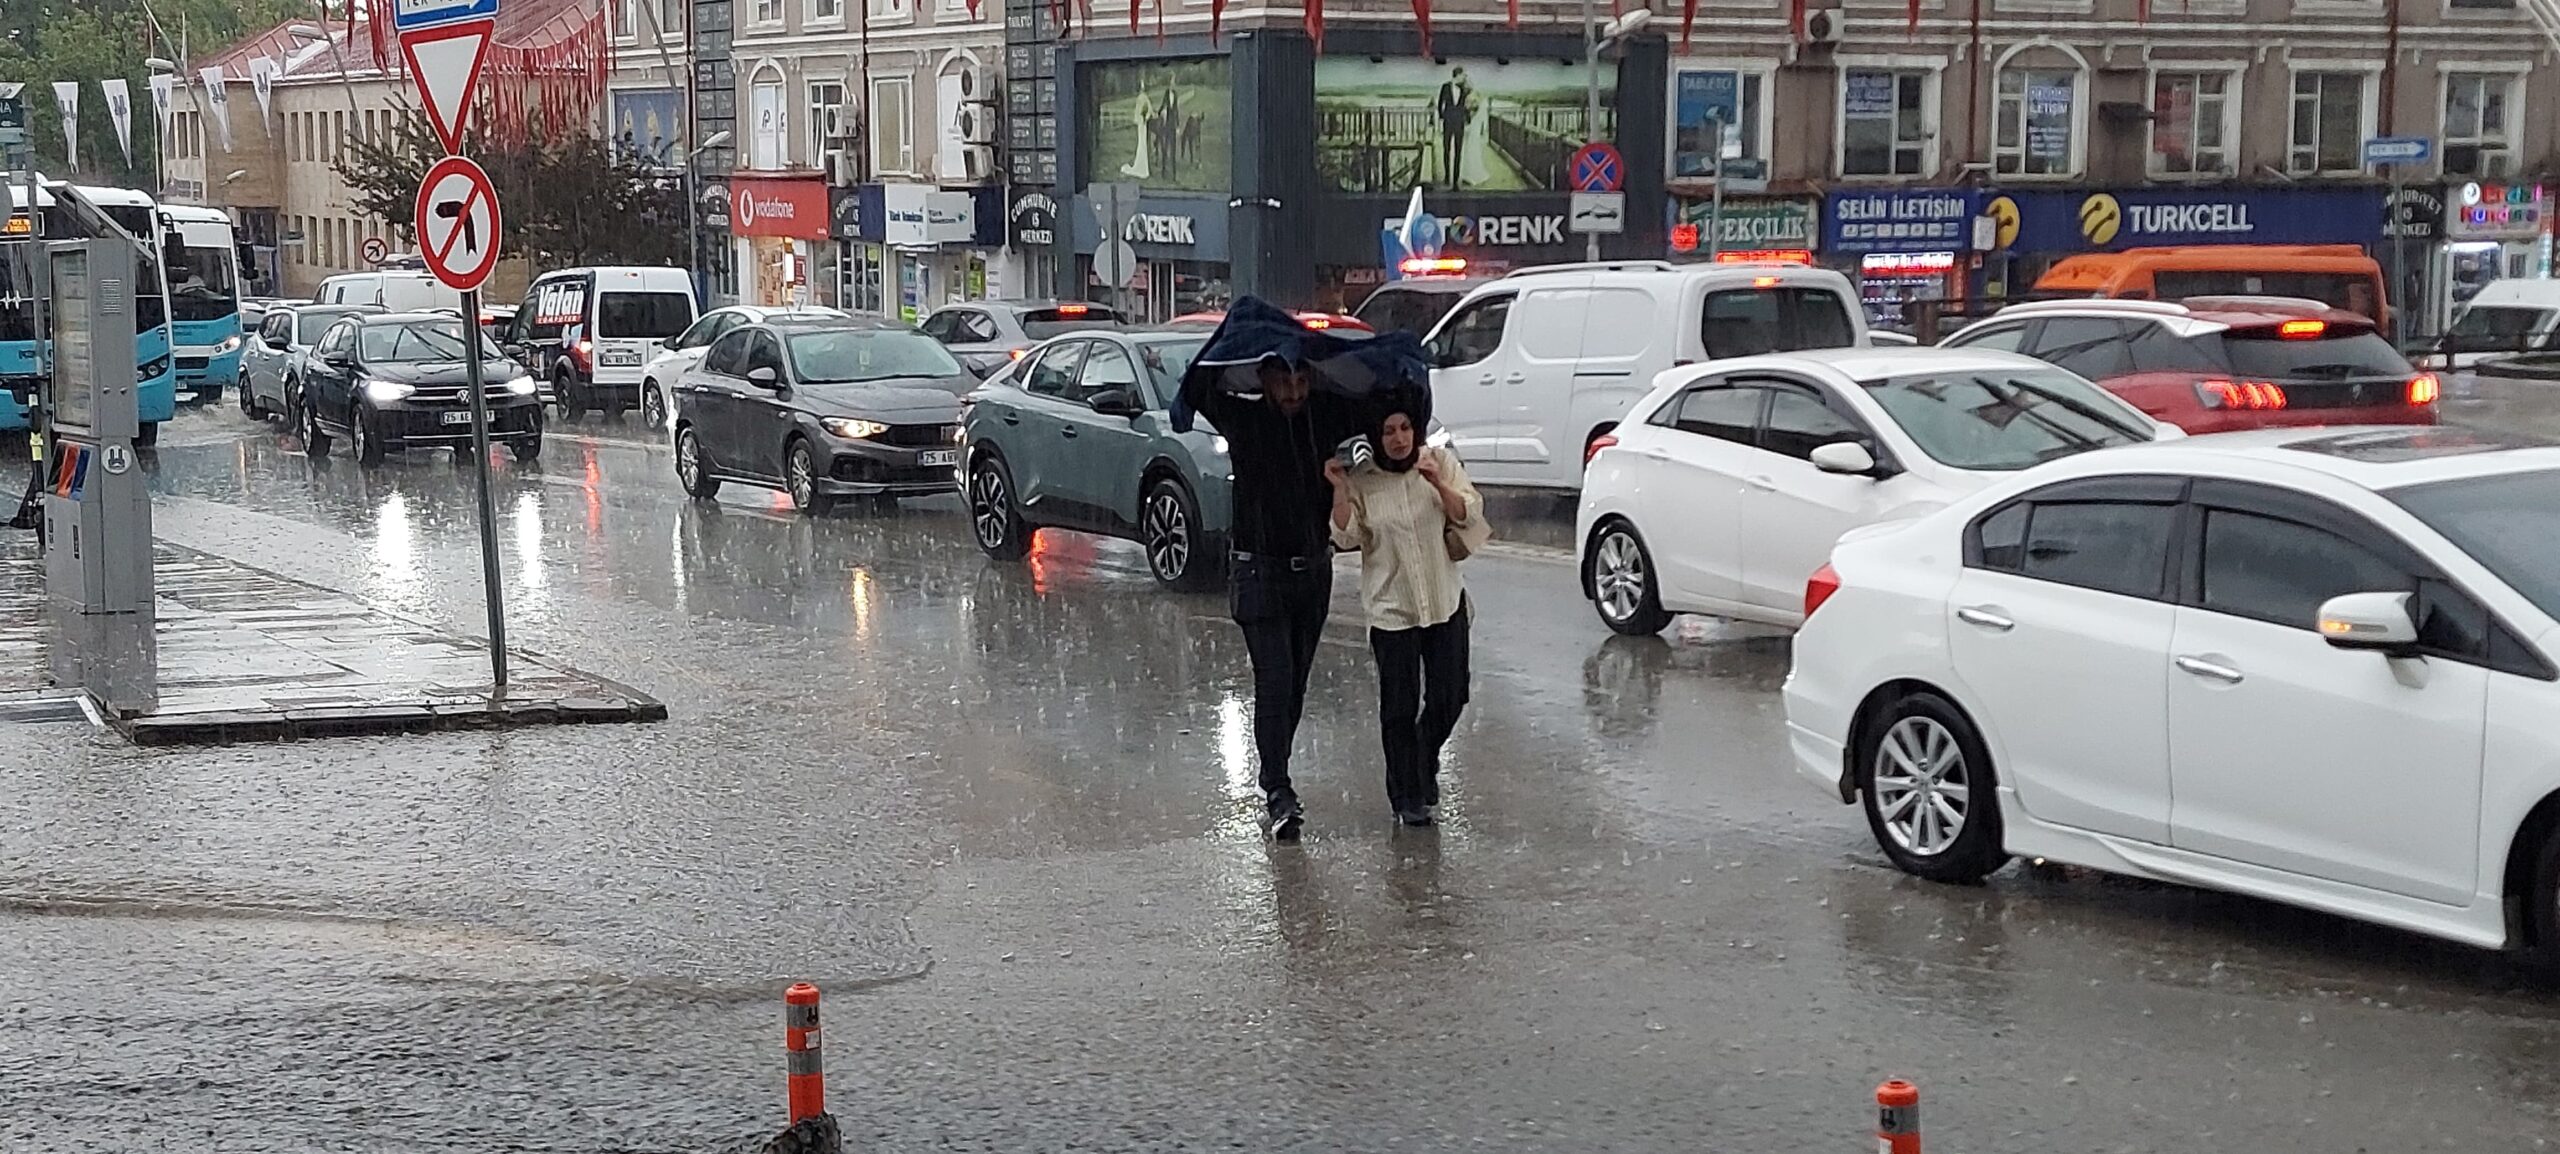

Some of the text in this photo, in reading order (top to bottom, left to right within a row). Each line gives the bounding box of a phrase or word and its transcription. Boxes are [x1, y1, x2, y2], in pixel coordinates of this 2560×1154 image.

[754, 197, 795, 219] vodafone
[1837, 194, 1887, 220] SELİN
[2129, 203, 2254, 233] TURKCELL
